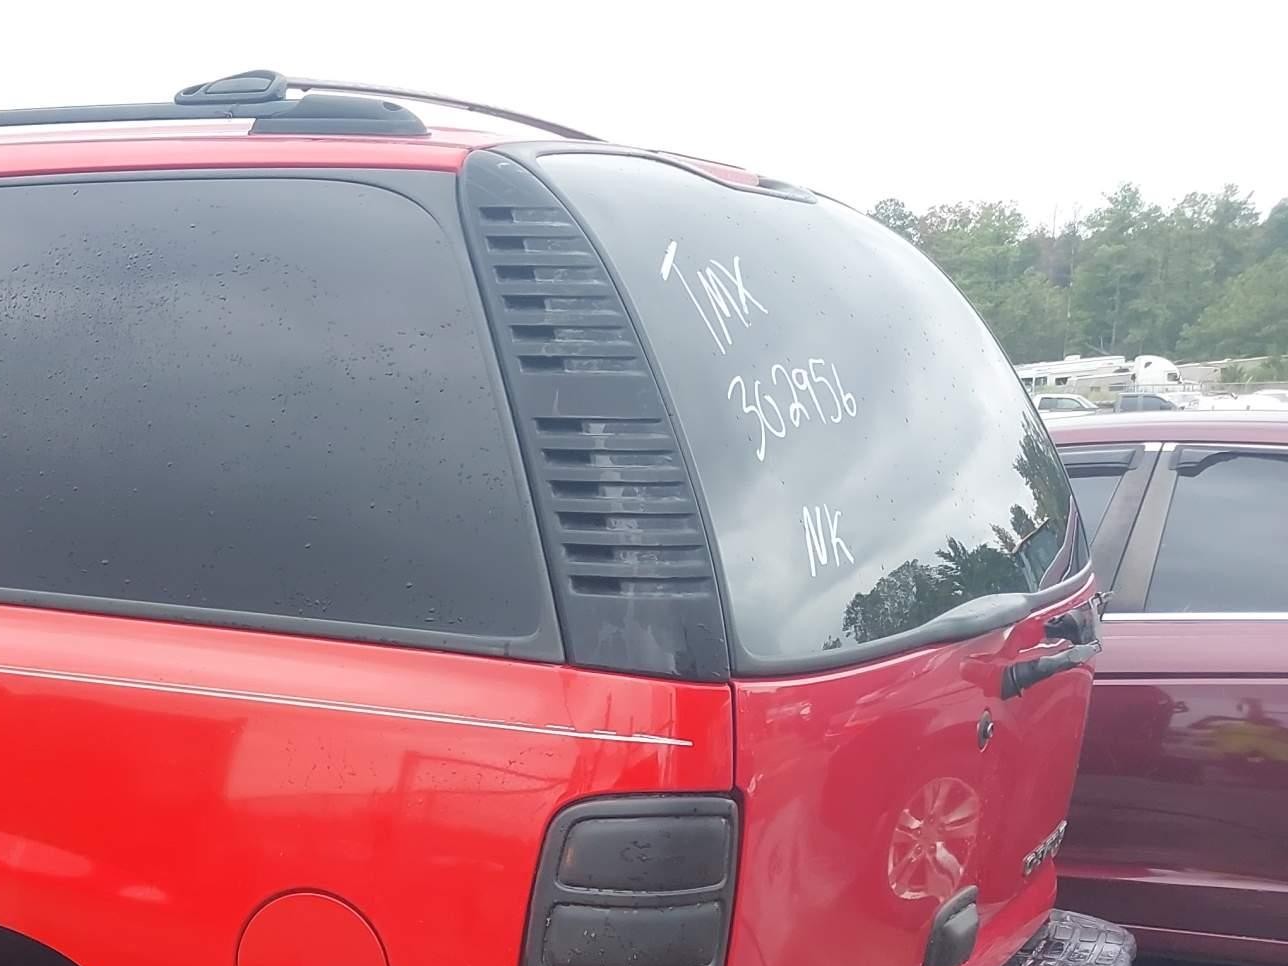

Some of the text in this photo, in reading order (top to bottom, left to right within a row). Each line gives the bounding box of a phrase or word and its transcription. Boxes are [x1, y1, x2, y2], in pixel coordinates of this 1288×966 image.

[661, 240, 769, 355] TMX
[727, 358, 858, 462] 302956
[802, 503, 855, 577] NK
